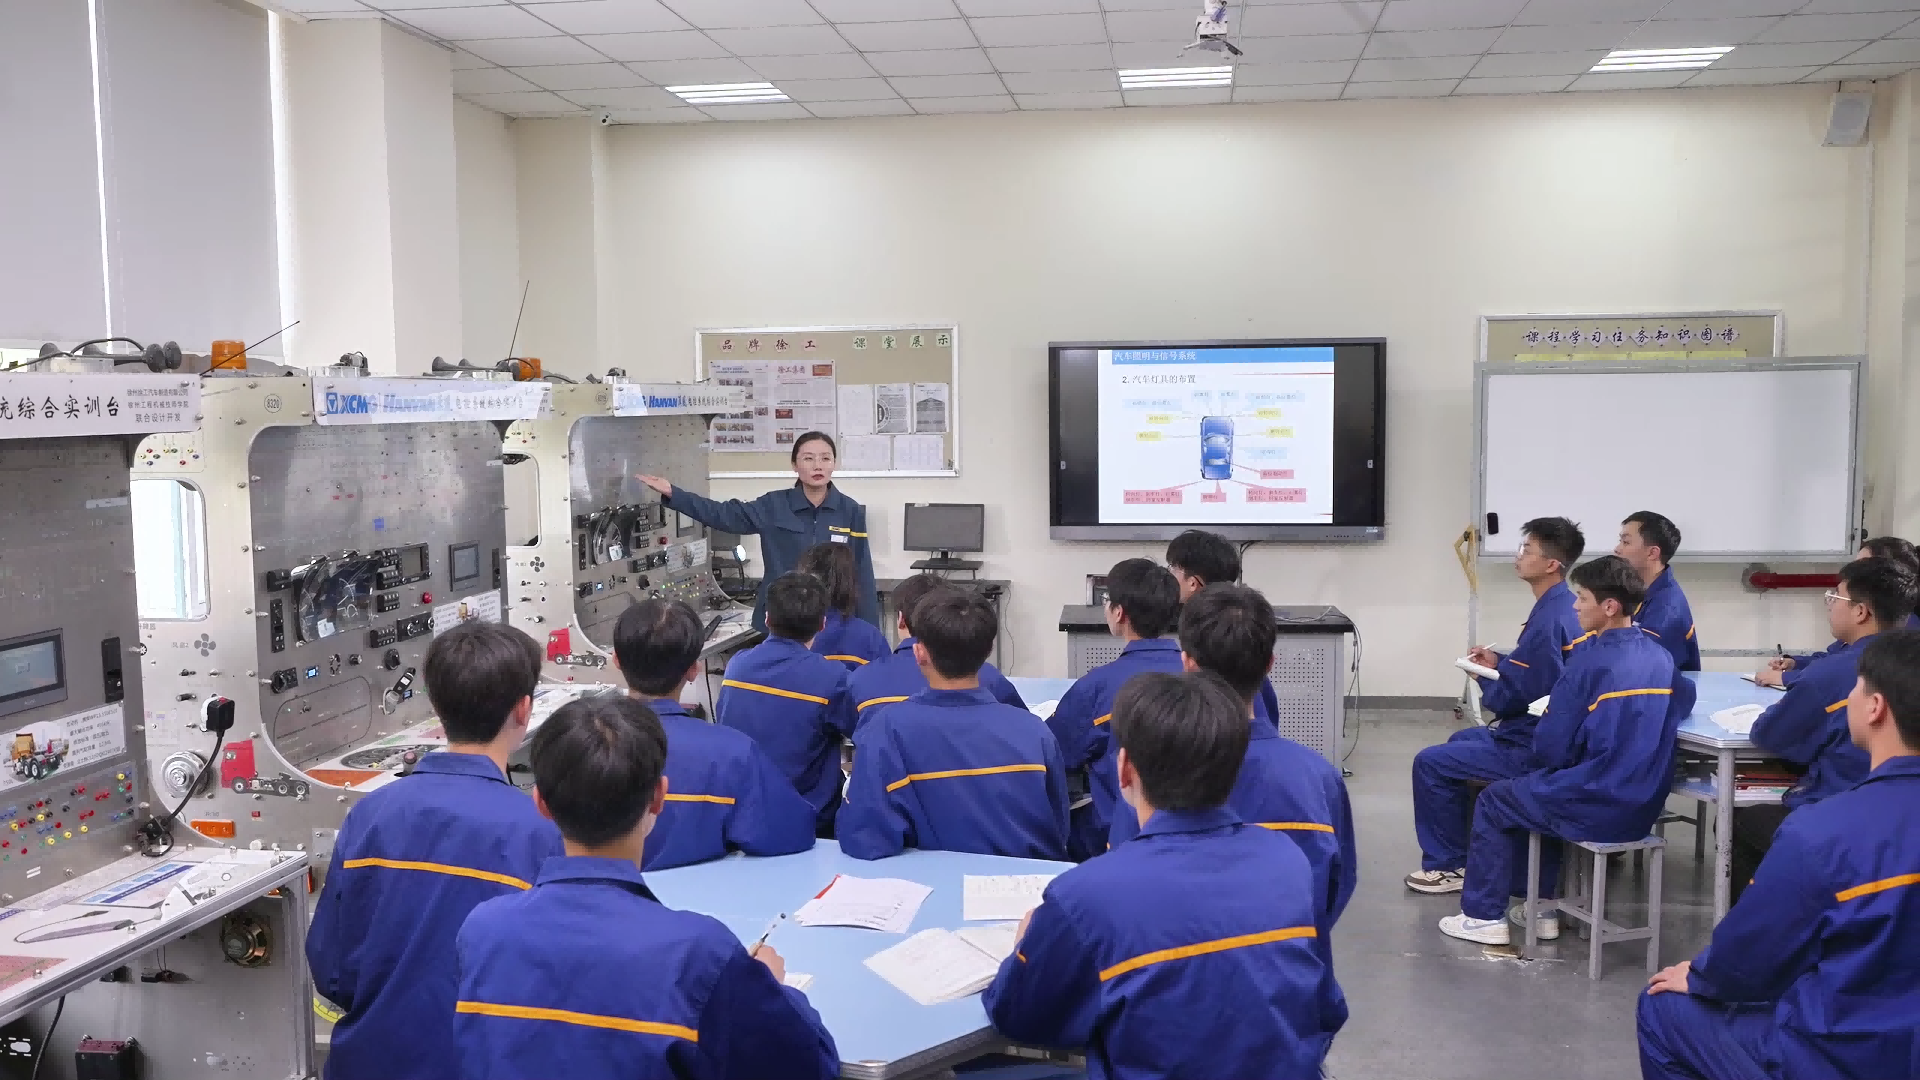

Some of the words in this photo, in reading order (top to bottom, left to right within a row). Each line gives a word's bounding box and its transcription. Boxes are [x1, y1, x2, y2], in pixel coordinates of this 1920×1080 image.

[1525, 324, 1735, 344] 课程学习任务知识图谱
[722, 338, 816, 350] 品牌徐工
[854, 335, 948, 349] 课堂展示
[1114, 351, 1196, 361] 汽车照明与信号系统
[1132, 374, 1196, 384] 汽车灯具的布置
[135, 412, 181, 424] 联合设计开发
